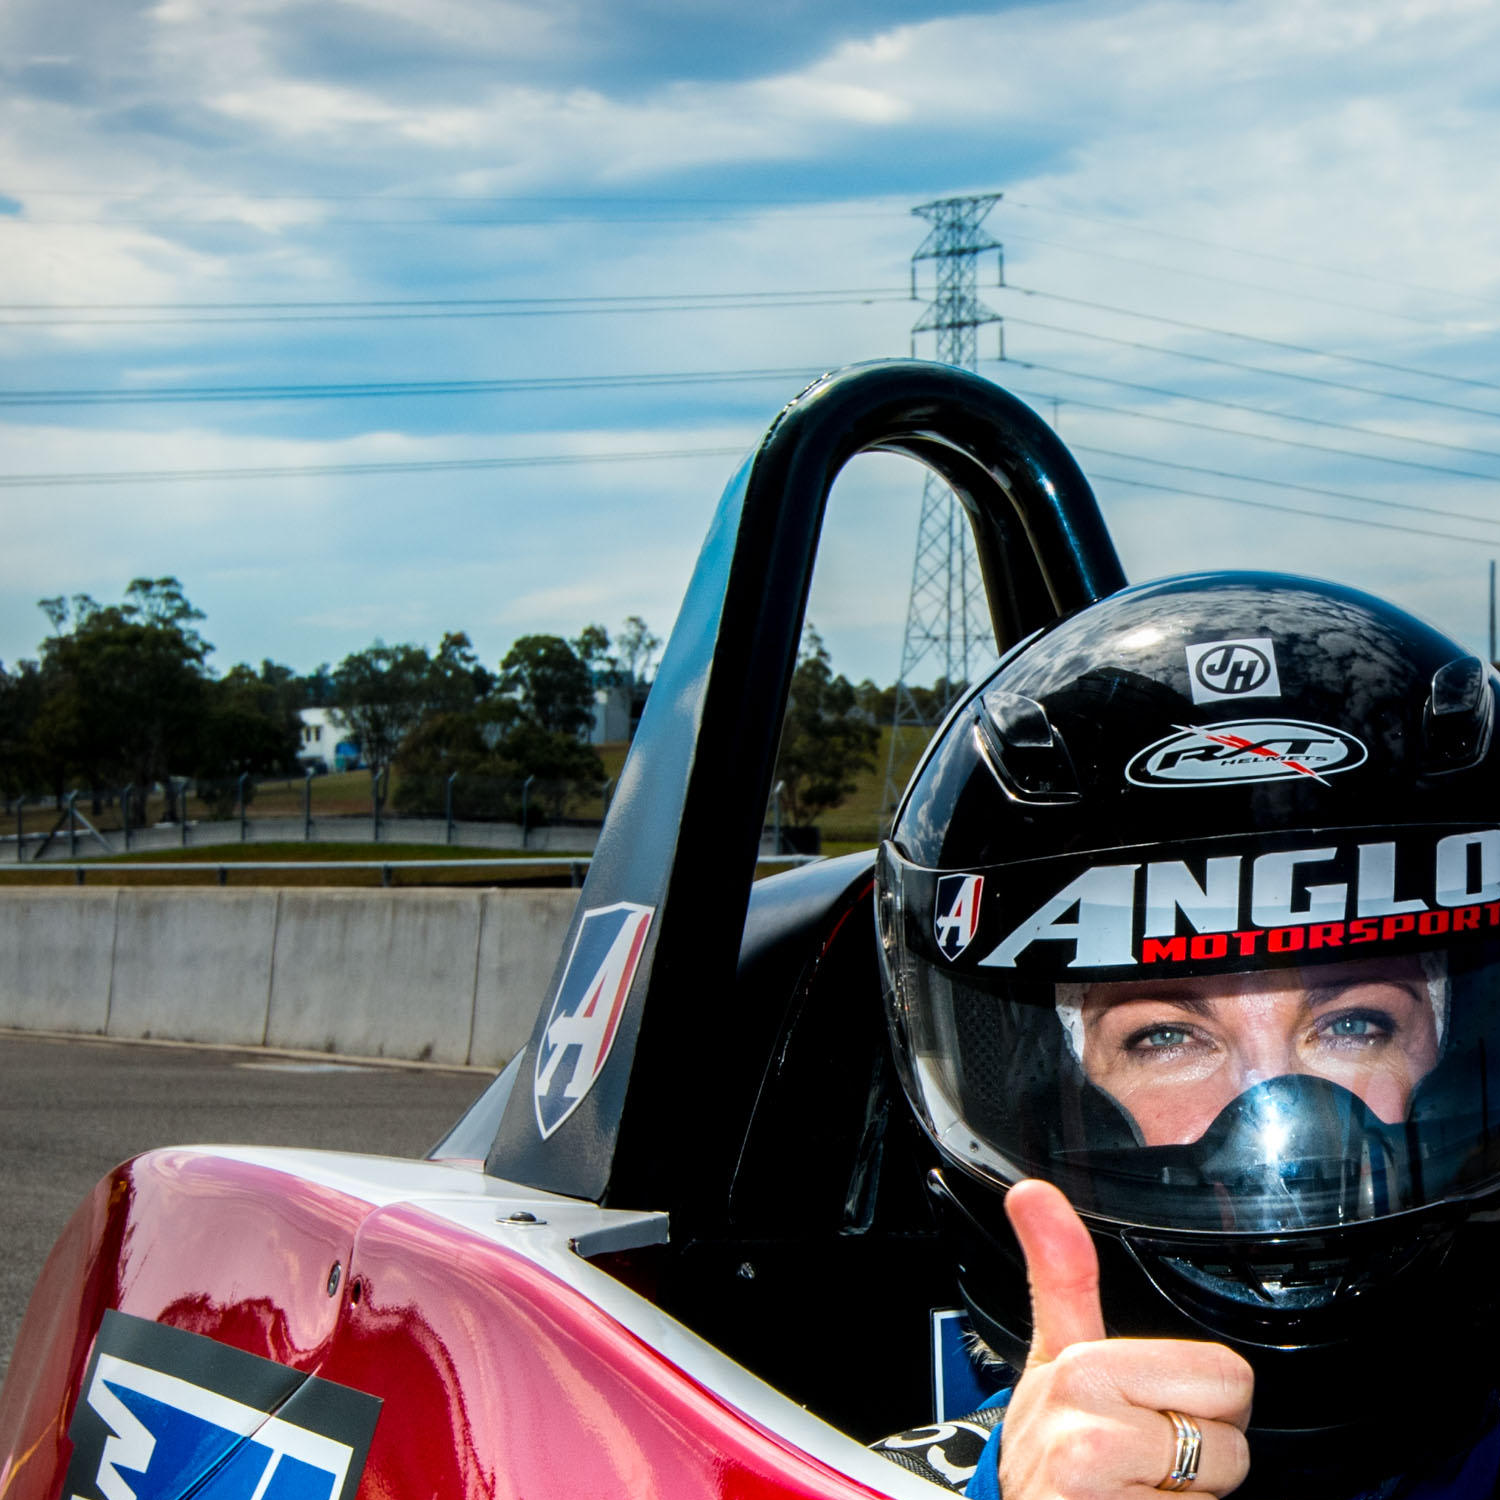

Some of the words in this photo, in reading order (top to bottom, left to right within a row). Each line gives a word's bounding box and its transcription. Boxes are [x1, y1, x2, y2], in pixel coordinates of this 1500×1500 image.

[1206, 646, 1260, 692] JH
[1155, 736, 1336, 772] RXT
[1221, 756, 1329, 767] HELMETS
